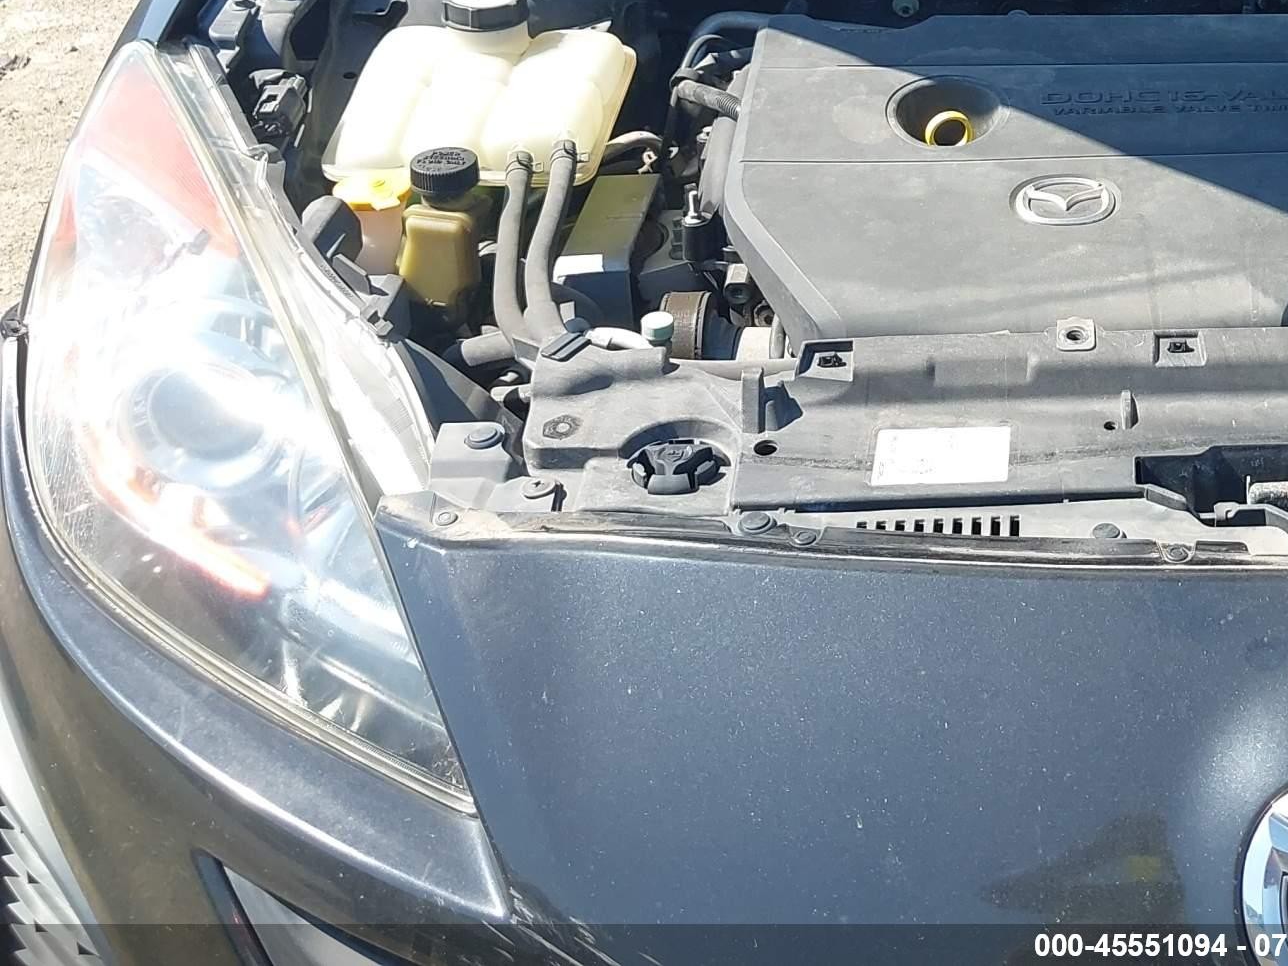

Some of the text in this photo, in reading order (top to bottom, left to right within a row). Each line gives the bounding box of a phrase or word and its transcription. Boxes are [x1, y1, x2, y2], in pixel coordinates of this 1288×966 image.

[1040, 90, 1161, 105] DOHC
[1054, 105, 1168, 116] VARIABLE
[1174, 103, 1242, 114] VALVE
